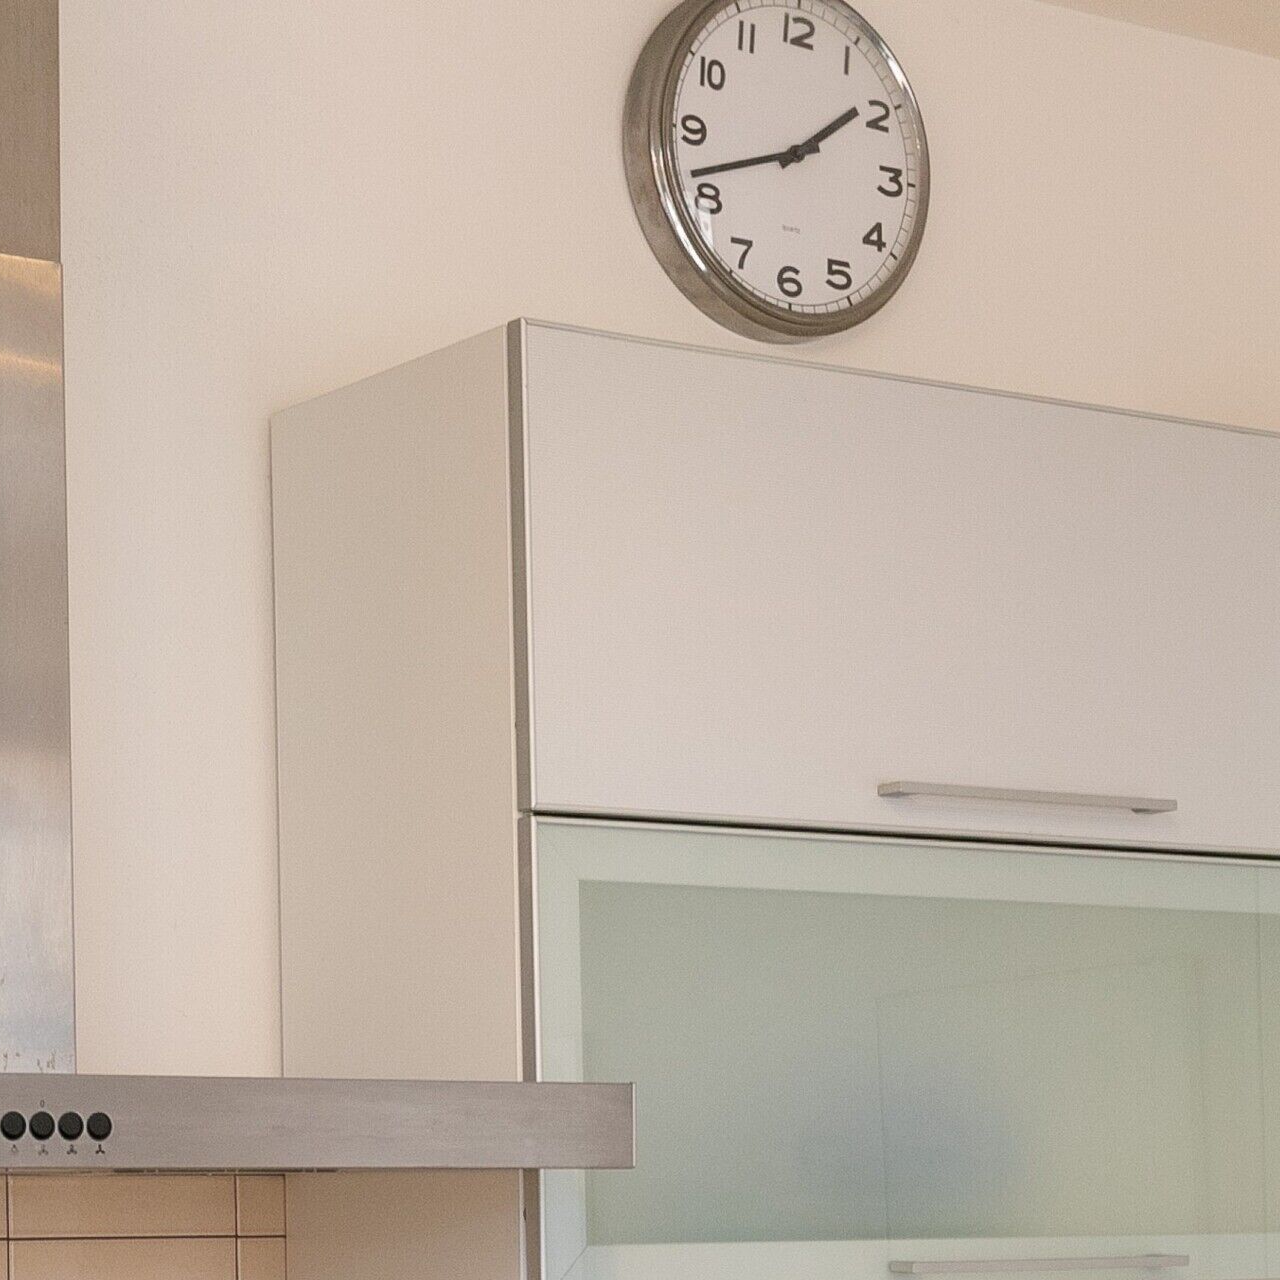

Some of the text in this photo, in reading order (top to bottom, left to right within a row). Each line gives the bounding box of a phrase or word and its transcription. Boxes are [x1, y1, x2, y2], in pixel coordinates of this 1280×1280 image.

[738, 20, 756, 54] 11
[783, 12, 816, 51] 12
[700, 55, 726, 91] 10
[843, 45, 850, 76] 1
[680, 114, 708, 147] 9
[865, 99, 891, 133] 2
[877, 164, 904, 198] 3
[694, 182, 723, 215] 8
[730, 236, 754, 270] 7
[862, 222, 887, 253] 4
[776, 265, 803, 298] 6
[825, 257, 853, 291] 5
